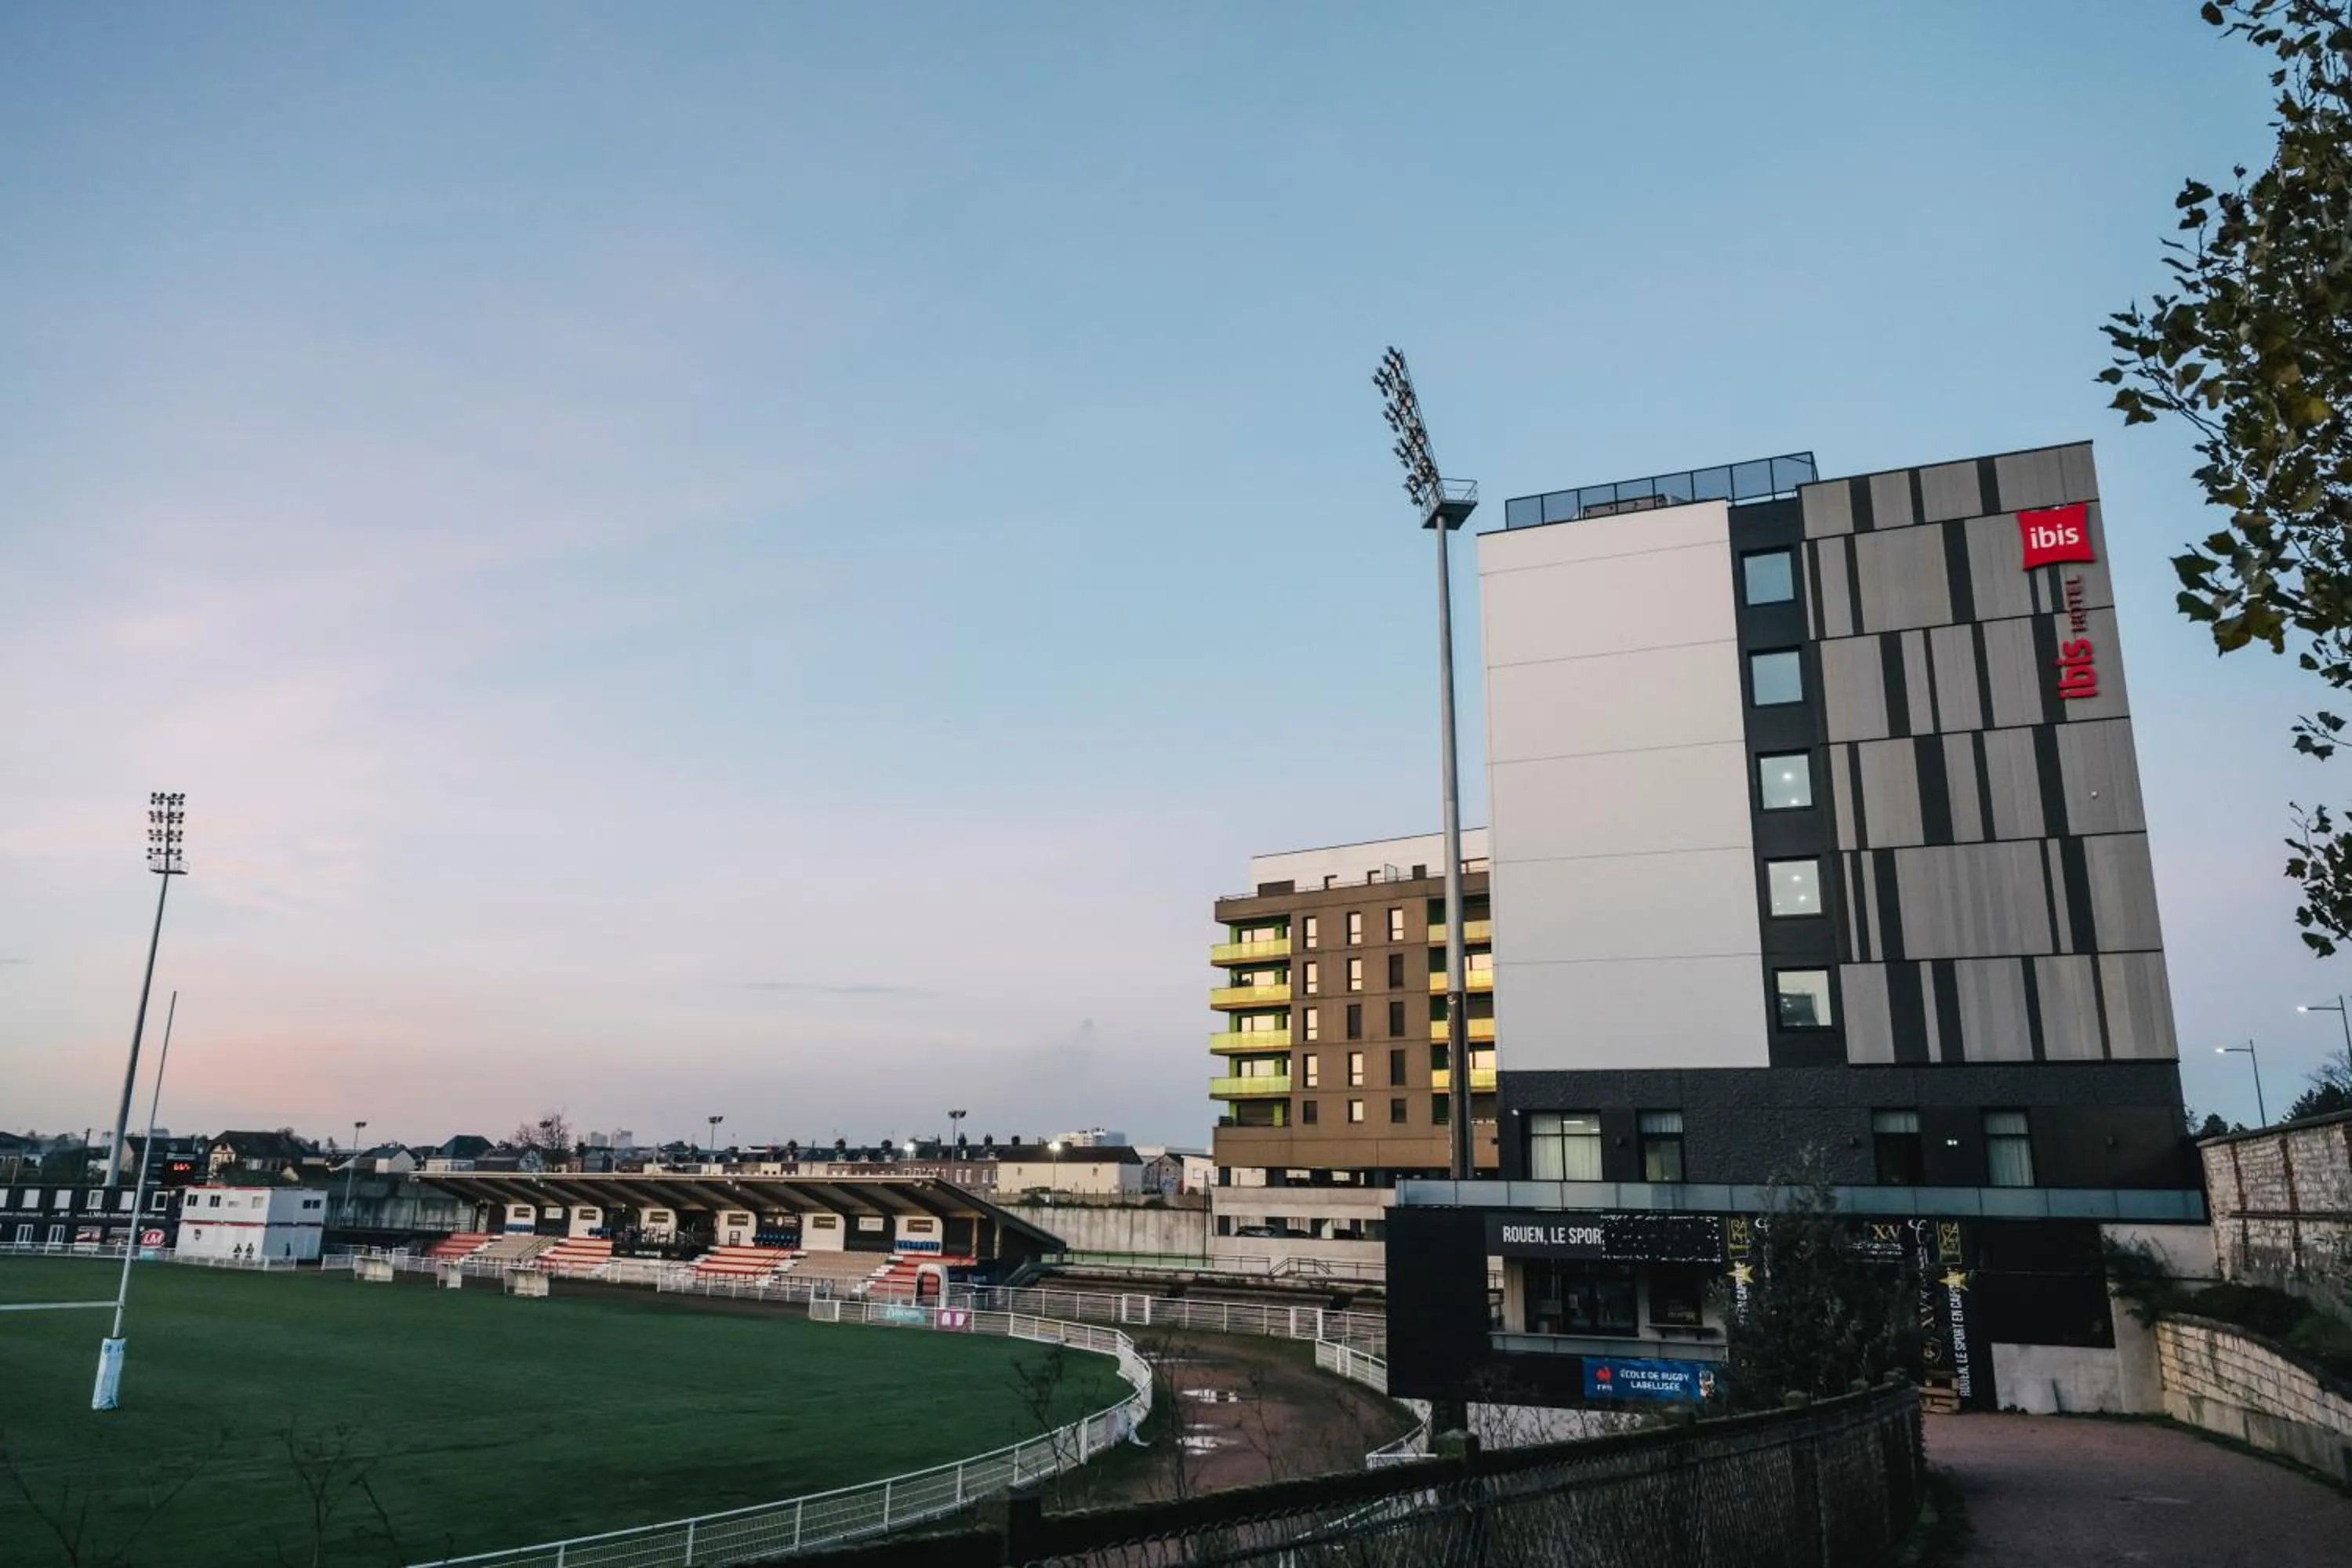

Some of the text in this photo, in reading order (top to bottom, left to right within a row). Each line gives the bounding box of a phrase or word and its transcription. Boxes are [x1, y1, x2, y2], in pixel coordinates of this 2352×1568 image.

[2029, 523, 2079, 550] ibis
[2055, 575, 2100, 699] ibis HOTEL
[1502, 1225, 1548, 1245] ROUEN,
[1550, 1226, 1566, 1244] LE
[1950, 1309, 1963, 1322] EN
[1952, 1323, 1967, 1351] SPORT
[1955, 1352, 1968, 1364] LE
[1647, 1371, 1659, 1380] DE
[1661, 1371, 1690, 1381] RUGBY
